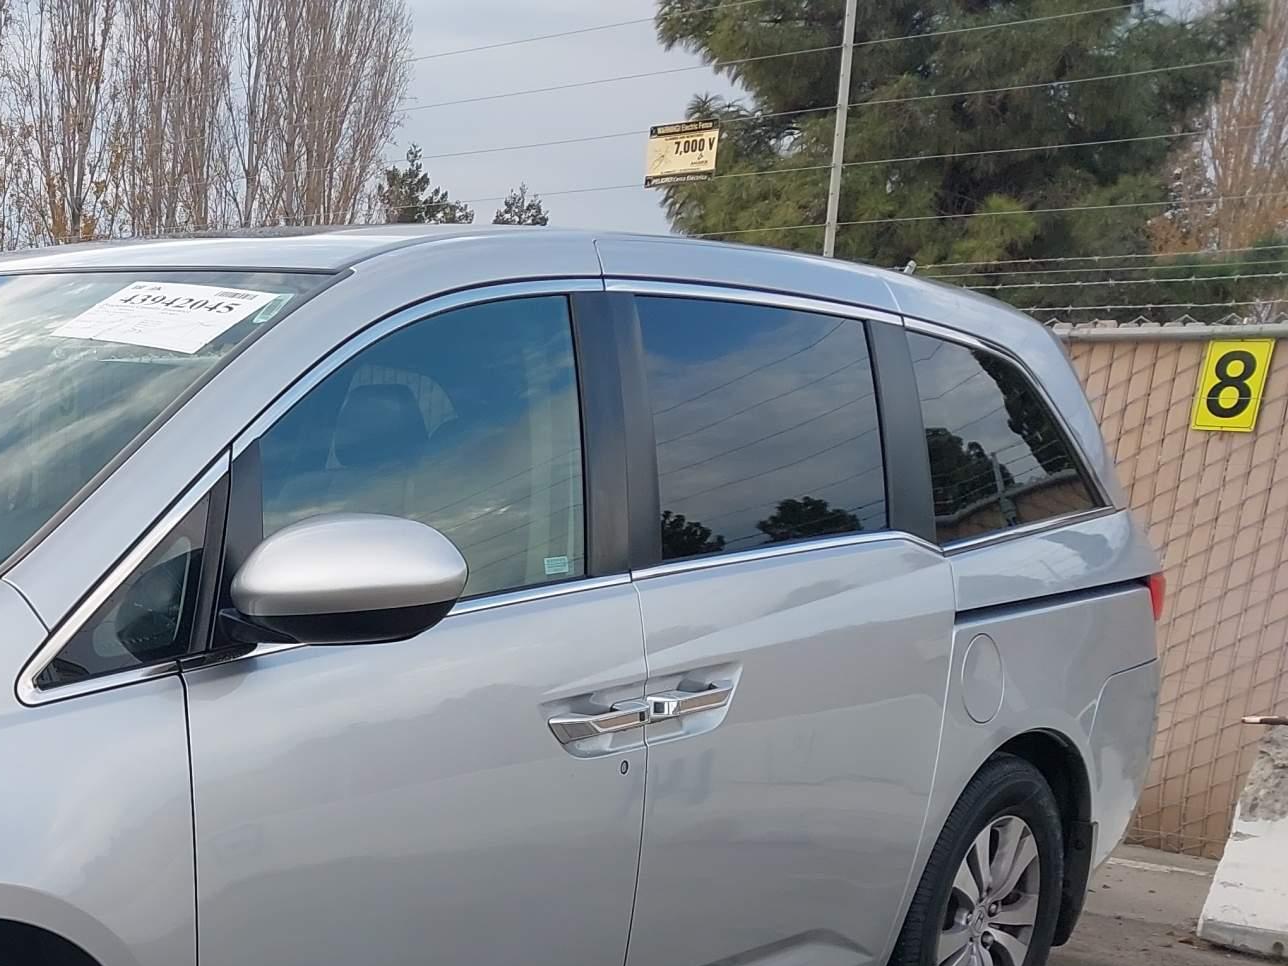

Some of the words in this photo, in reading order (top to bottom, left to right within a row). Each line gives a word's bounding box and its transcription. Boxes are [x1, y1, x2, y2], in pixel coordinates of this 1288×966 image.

[674, 138, 705, 156] 7,000
[708, 137, 715, 151] V
[119, 293, 241, 314] 43942045
[1207, 349, 1257, 418] 8
